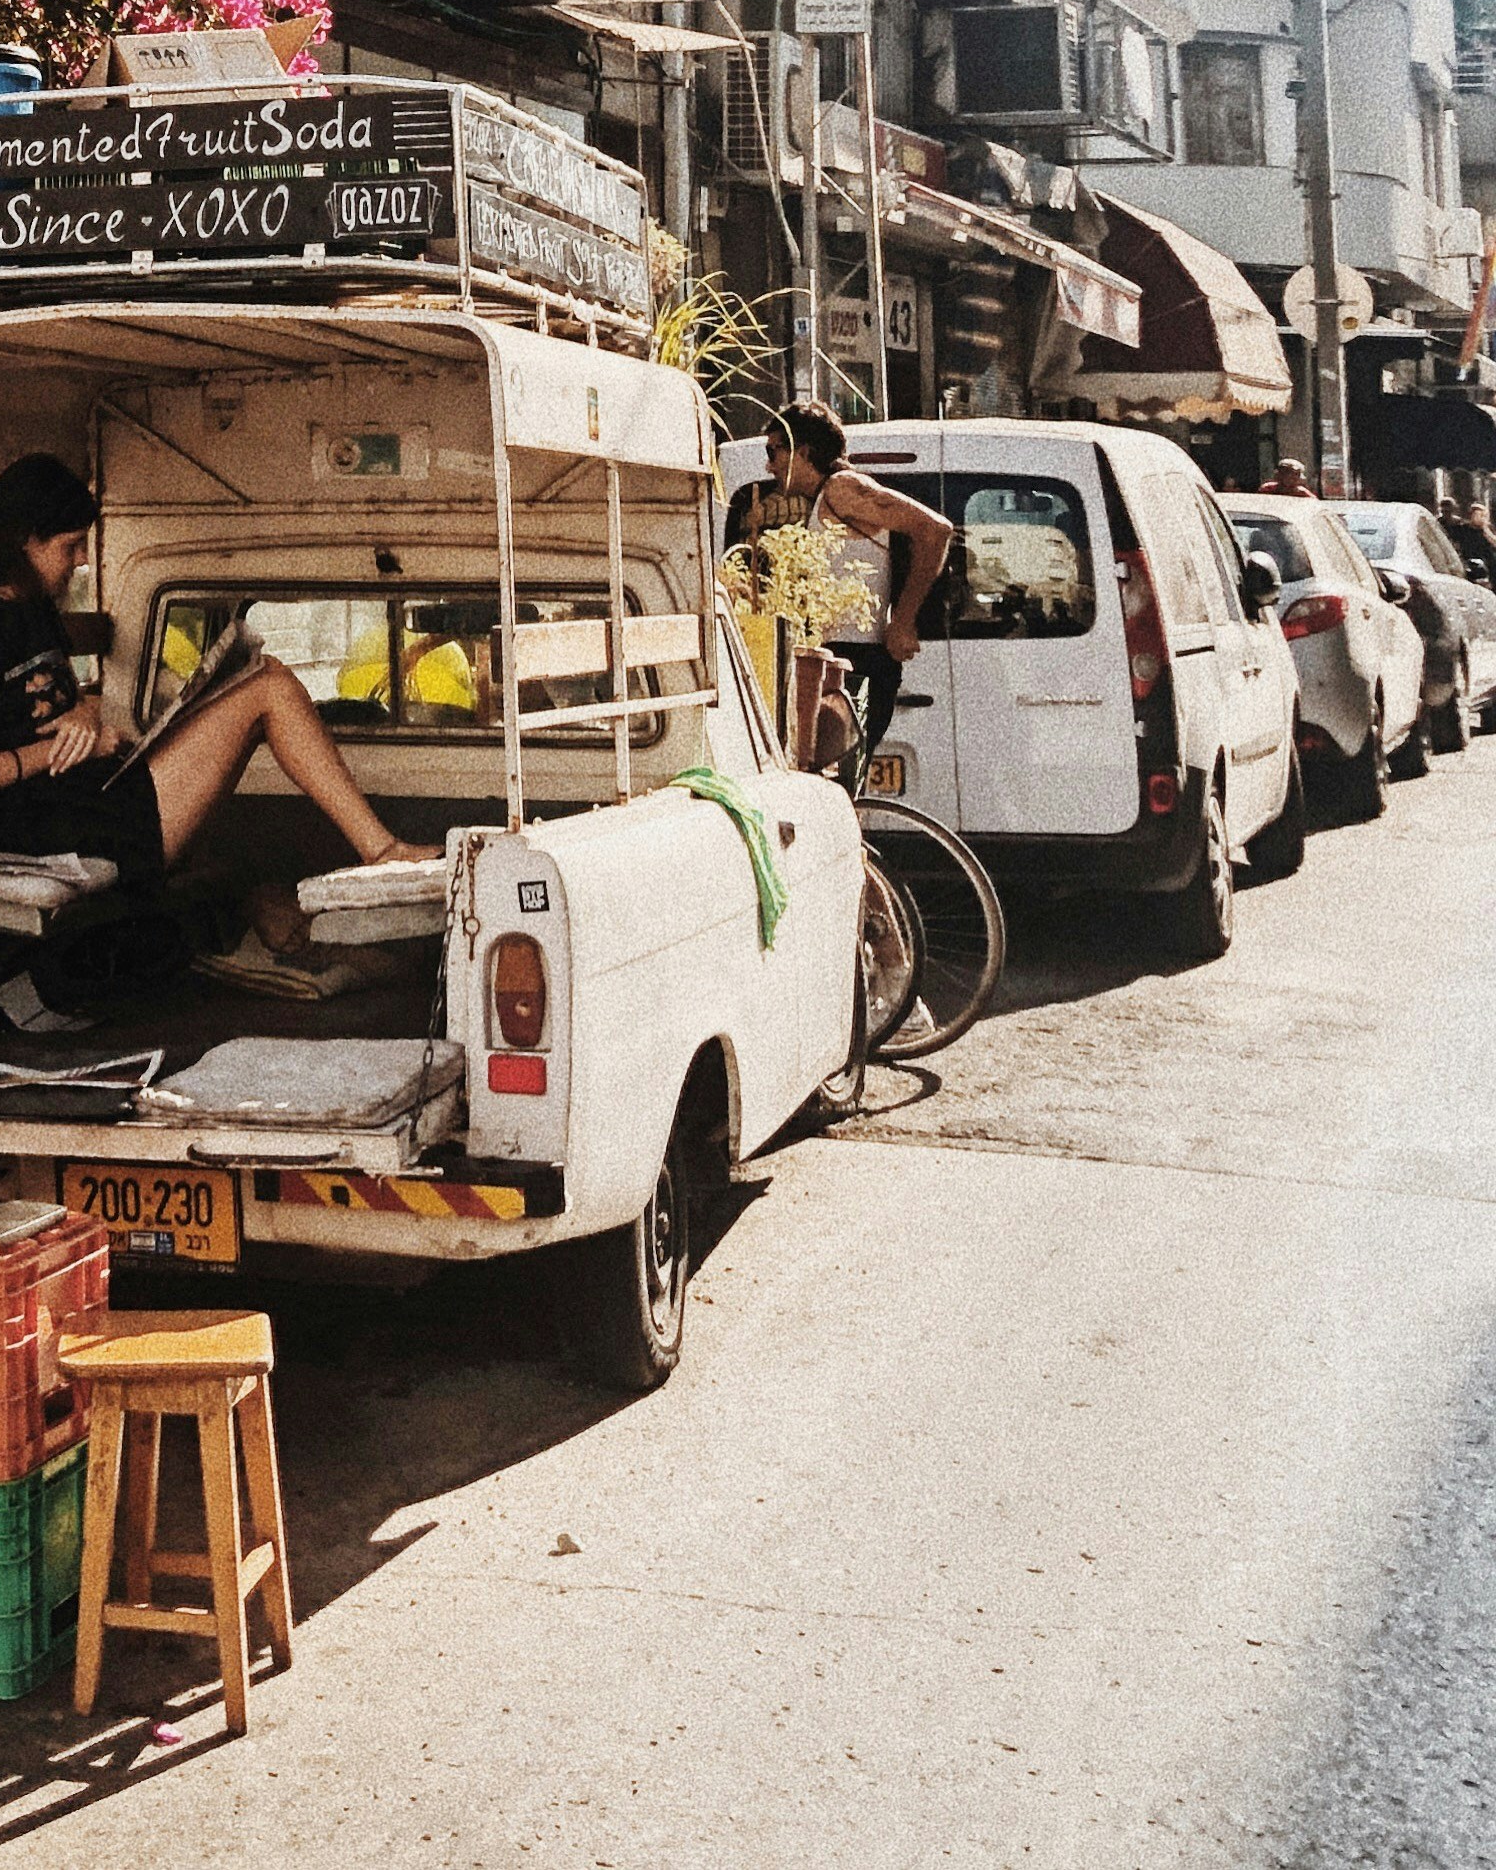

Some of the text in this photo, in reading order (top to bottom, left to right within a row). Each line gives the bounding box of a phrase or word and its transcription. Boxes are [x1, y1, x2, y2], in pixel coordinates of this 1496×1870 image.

[258, 98, 372, 157] Soda
[160, 184, 290, 240] XOXO
[340, 185, 423, 232] gazoz
[889, 299, 912, 346] 43
[185, 1233, 212, 1251] רכב
